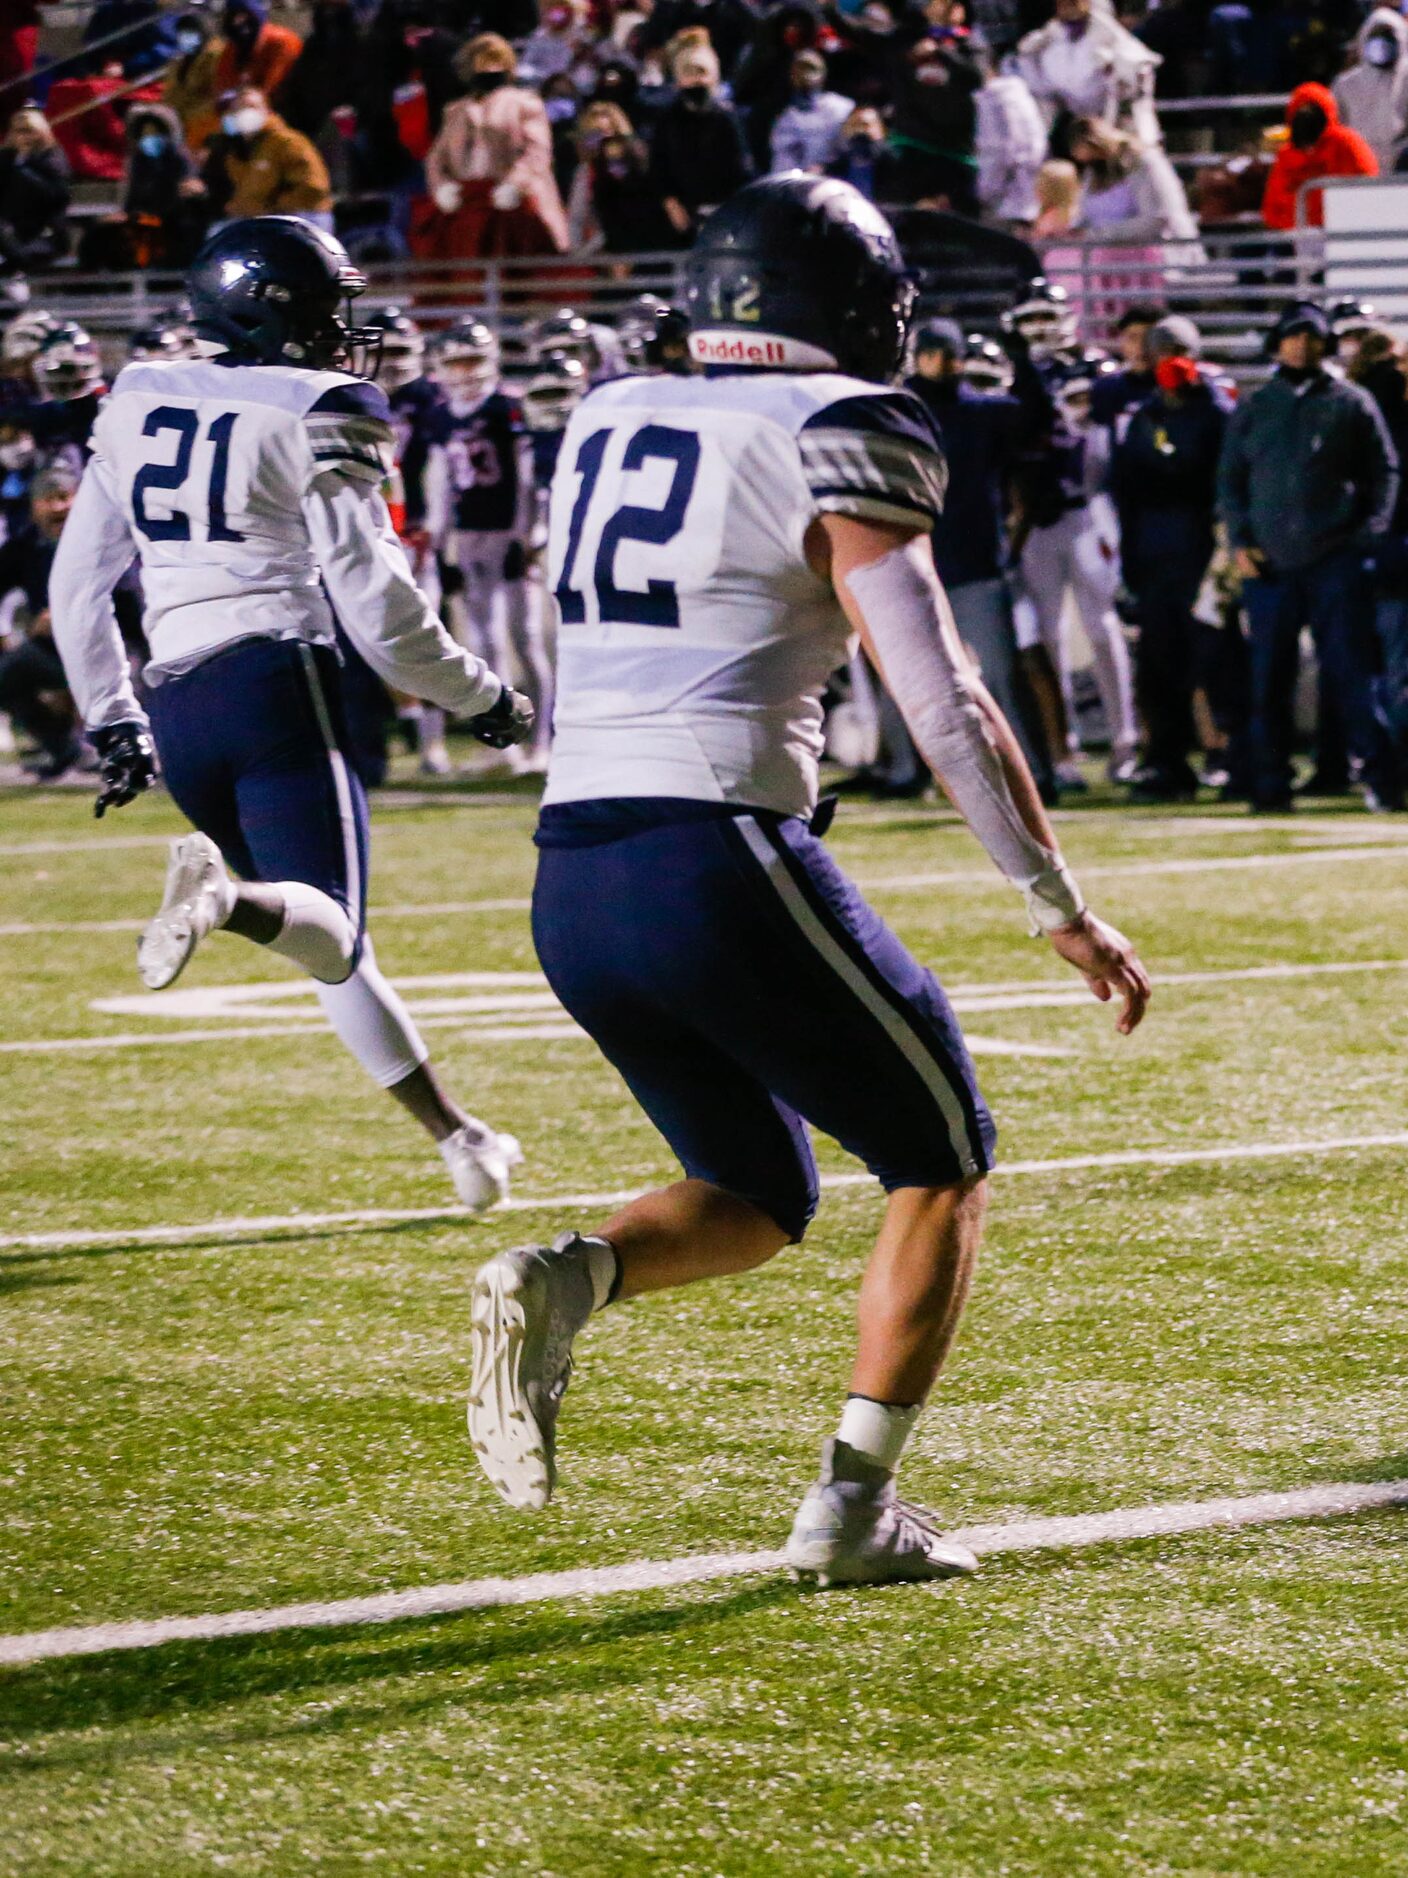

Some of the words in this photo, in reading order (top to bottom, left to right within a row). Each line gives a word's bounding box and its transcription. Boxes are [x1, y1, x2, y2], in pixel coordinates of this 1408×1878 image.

[708, 274, 760, 321] 12
[696, 338, 785, 364] Riddell
[132, 405, 248, 542] 21
[553, 424, 702, 628] 12
